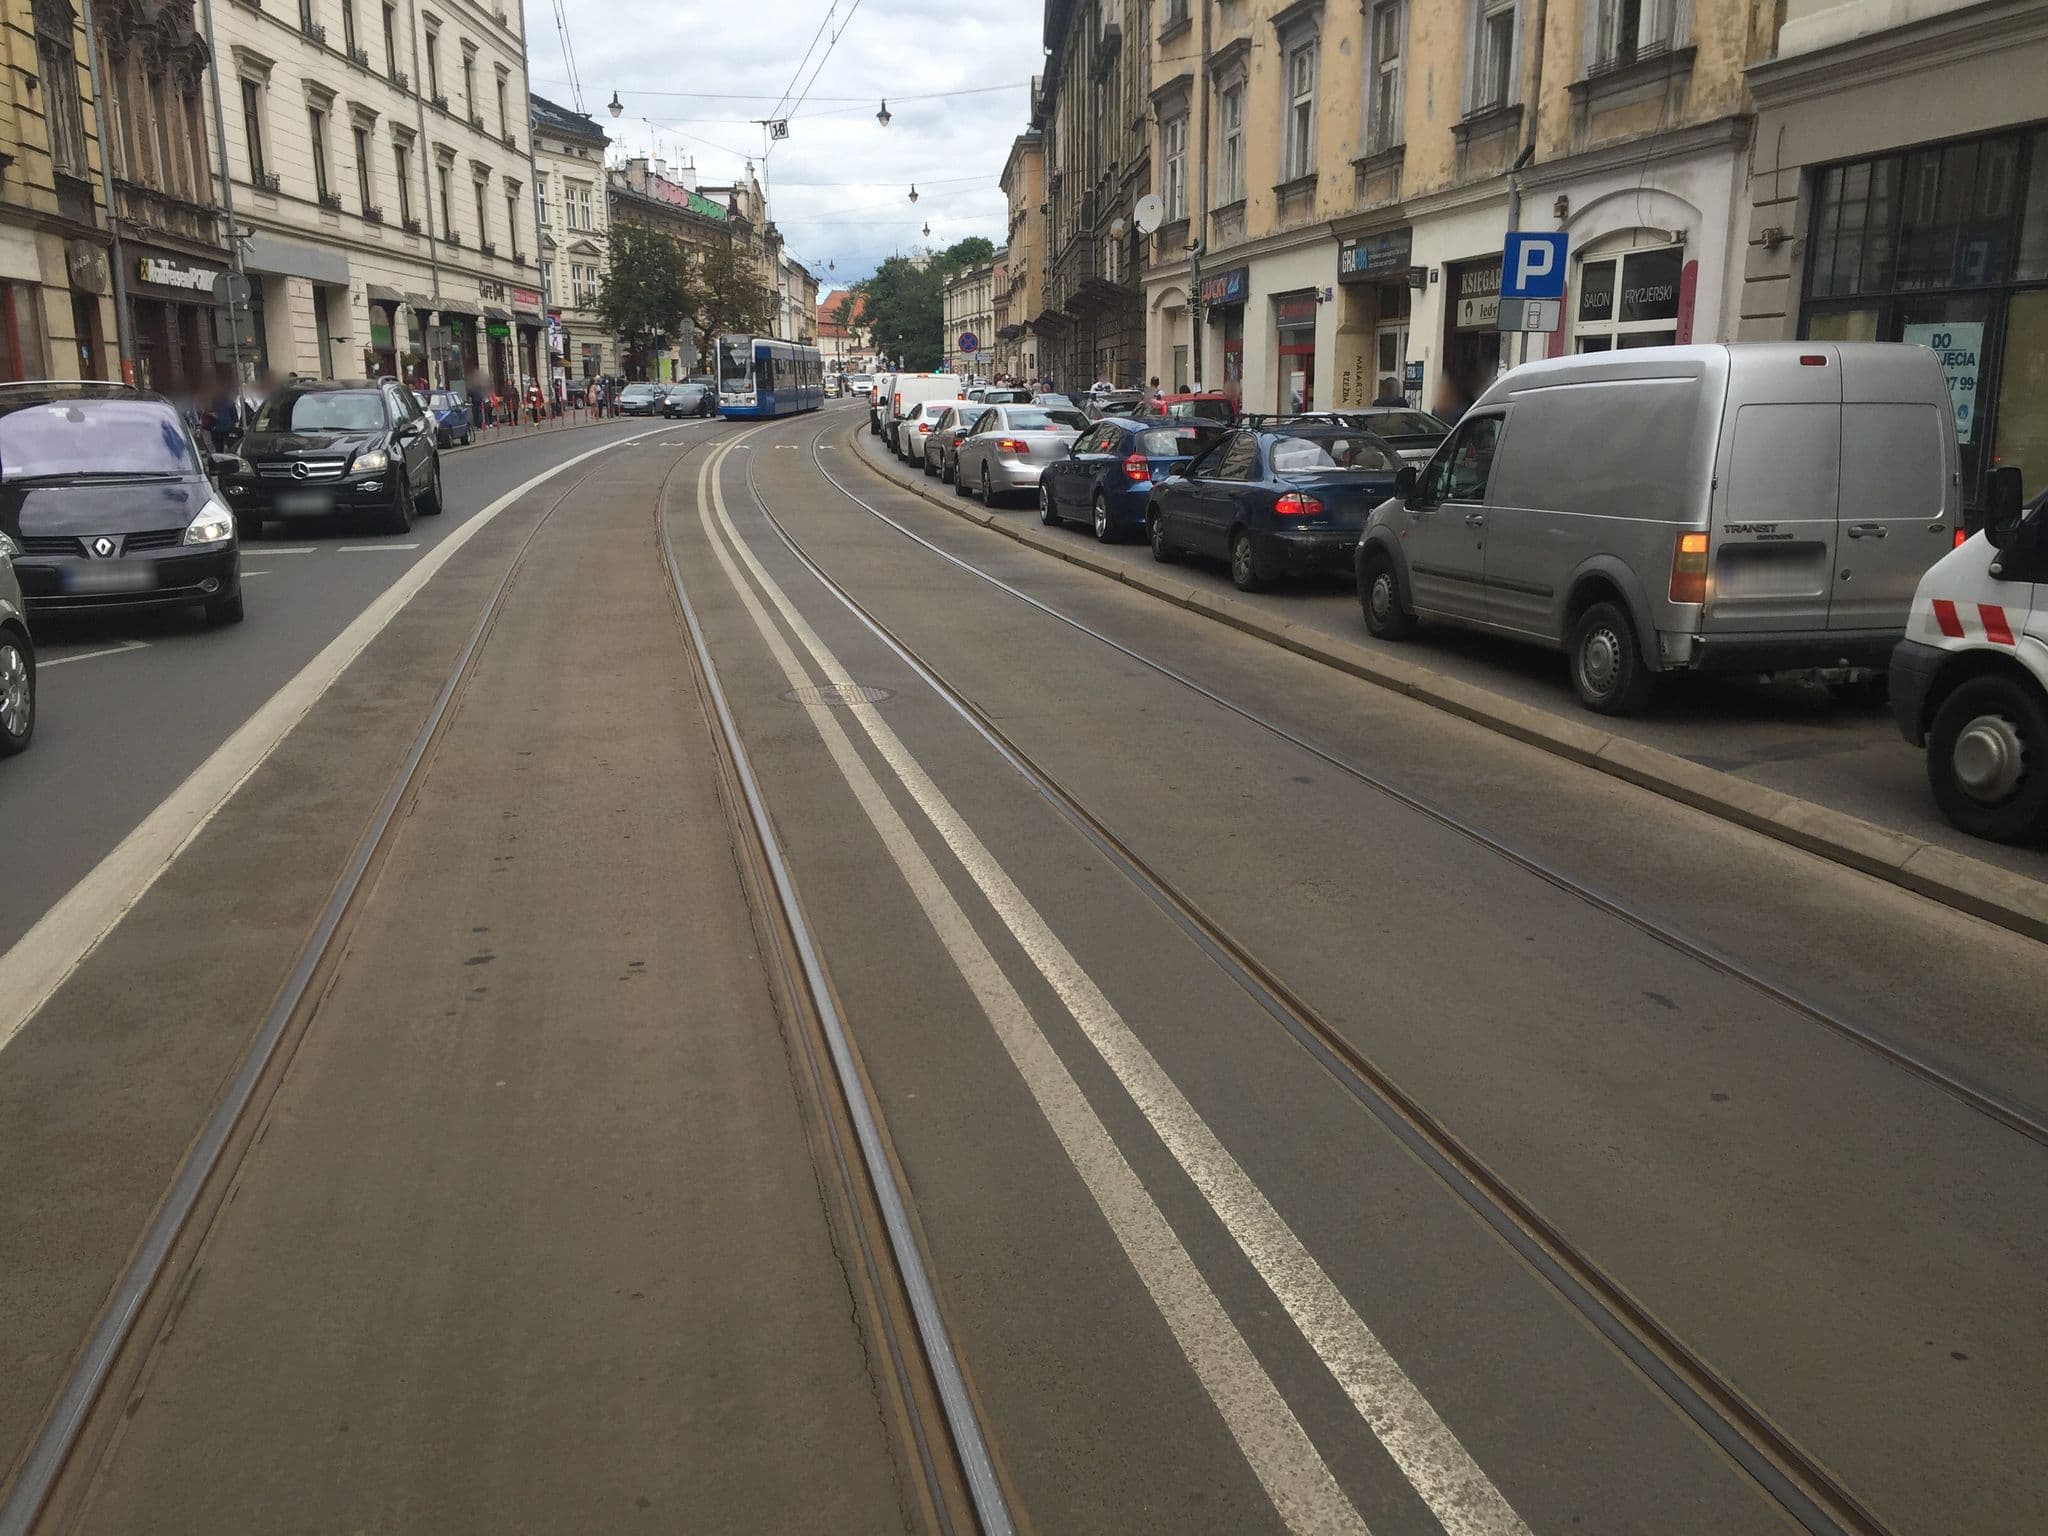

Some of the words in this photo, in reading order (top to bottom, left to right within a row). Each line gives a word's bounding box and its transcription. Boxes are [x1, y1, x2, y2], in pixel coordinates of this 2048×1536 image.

[1516, 240, 1554, 290] P
[1583, 292, 1611, 308] SALON
[1624, 284, 1673, 304] FRYZJERSKI
[1931, 333, 1952, 348] DO
[1938, 352, 1976, 369] JĘCIA
[1723, 524, 1778, 533] TRANSIT
